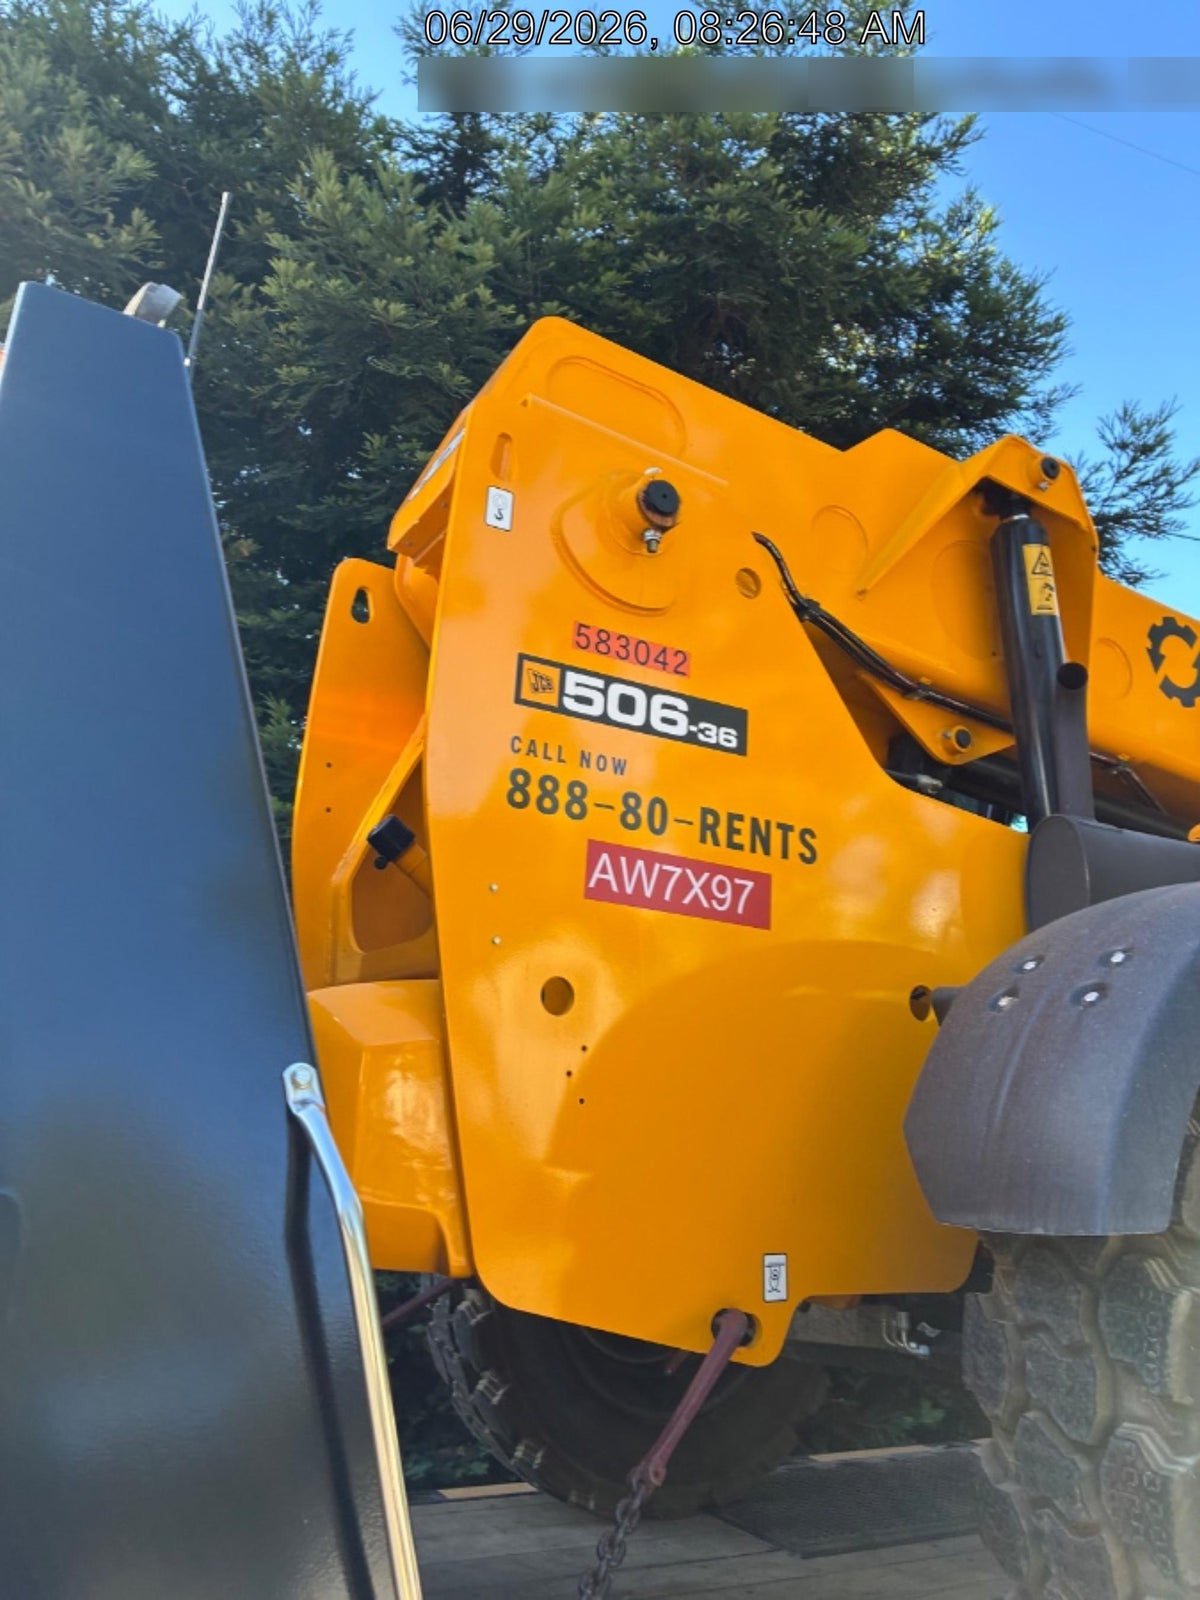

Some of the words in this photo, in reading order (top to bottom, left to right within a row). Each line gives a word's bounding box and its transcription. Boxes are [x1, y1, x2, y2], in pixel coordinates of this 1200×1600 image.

[574, 623, 689, 677] 583042
[562, 670, 739, 749] 506-36
[510, 735, 567, 764] CALL
[579, 749, 627, 776] NOW
[506, 767, 819, 865] 888-80-RENTS
[587, 852, 755, 915] AW7X97
